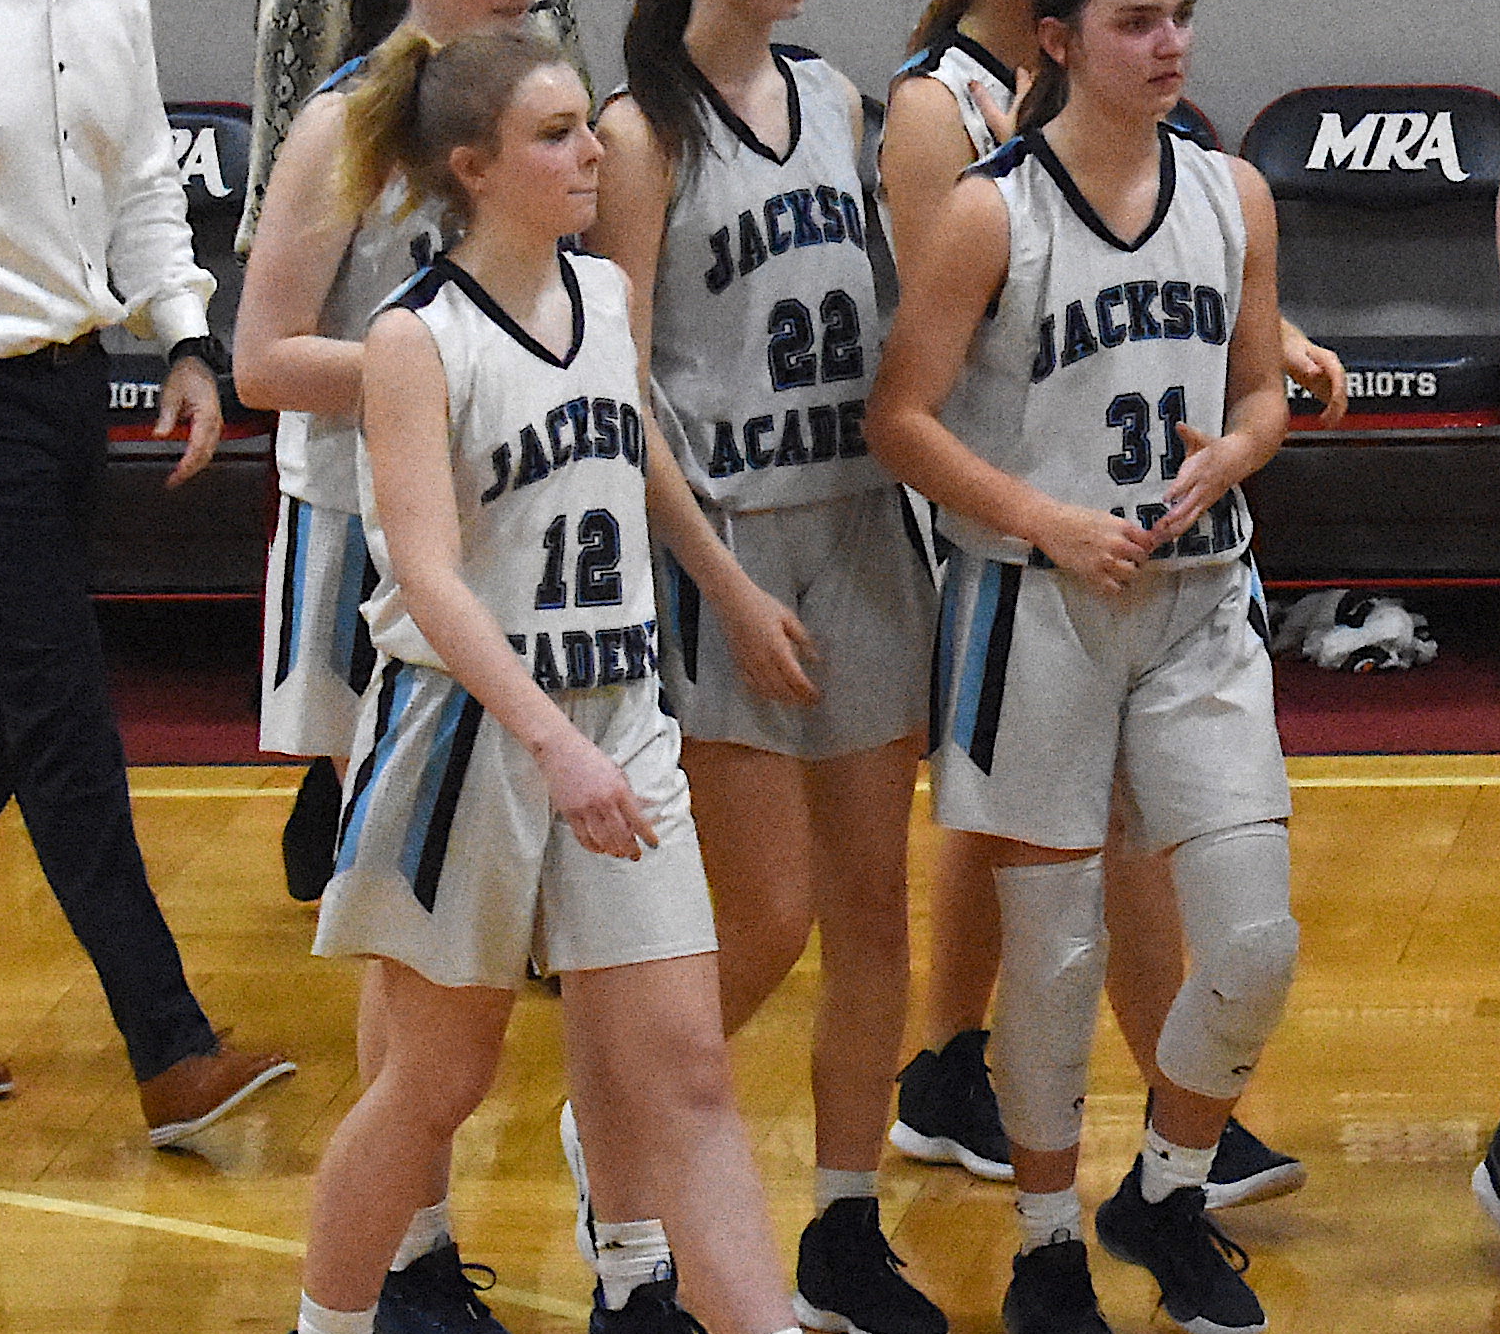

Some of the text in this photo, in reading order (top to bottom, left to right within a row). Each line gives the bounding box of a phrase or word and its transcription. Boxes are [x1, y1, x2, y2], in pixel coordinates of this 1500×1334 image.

[1304, 111, 1471, 182] MRA
[767, 289, 864, 392] 22
[1032, 280, 1230, 384] JACKSO
[481, 396, 647, 507] JACKSO
[1106, 386, 1188, 485] 31
[534, 508, 623, 610] 12
